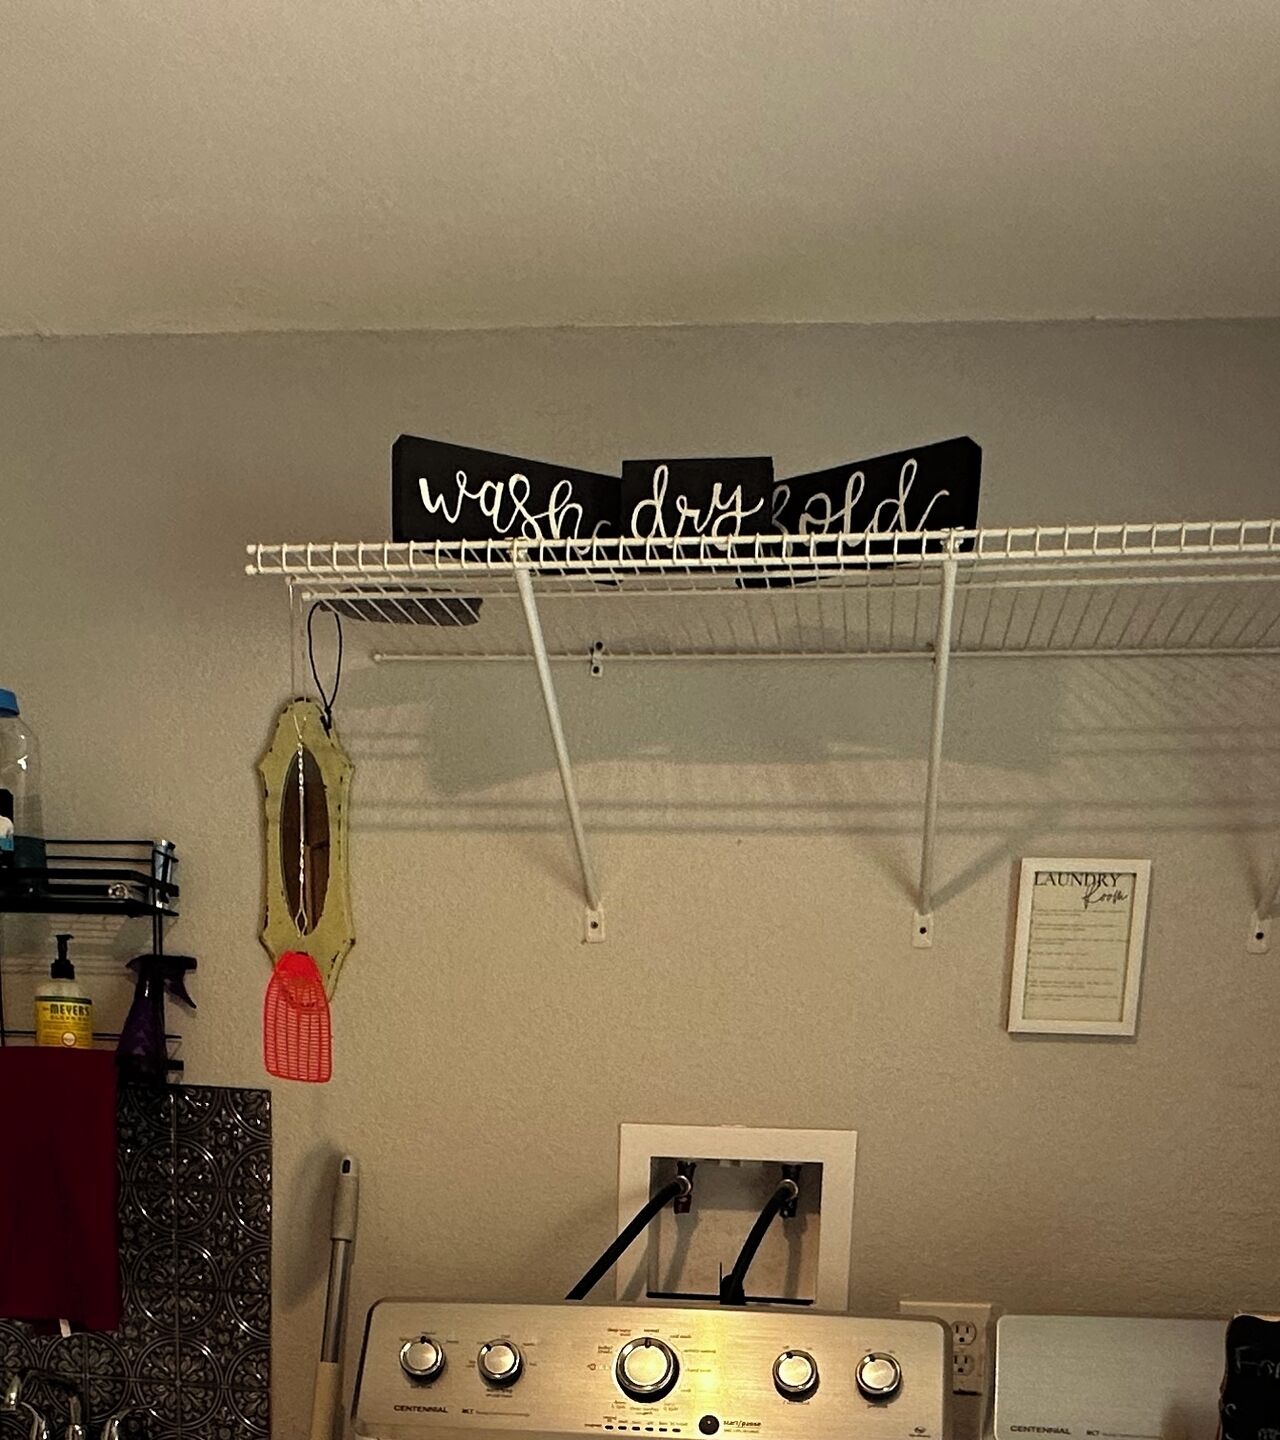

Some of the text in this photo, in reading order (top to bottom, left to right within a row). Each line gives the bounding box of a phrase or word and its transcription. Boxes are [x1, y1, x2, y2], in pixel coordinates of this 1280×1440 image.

[419, 470, 611, 555] wash
[631, 465, 764, 551] dry
[1034, 872, 1122, 888] LAUNDRY
[50, 1003, 90, 1017] MEYERS
[393, 1404, 449, 1414] CENTENNIAL
[1010, 1425, 1071, 1435] CENTENNIAL
